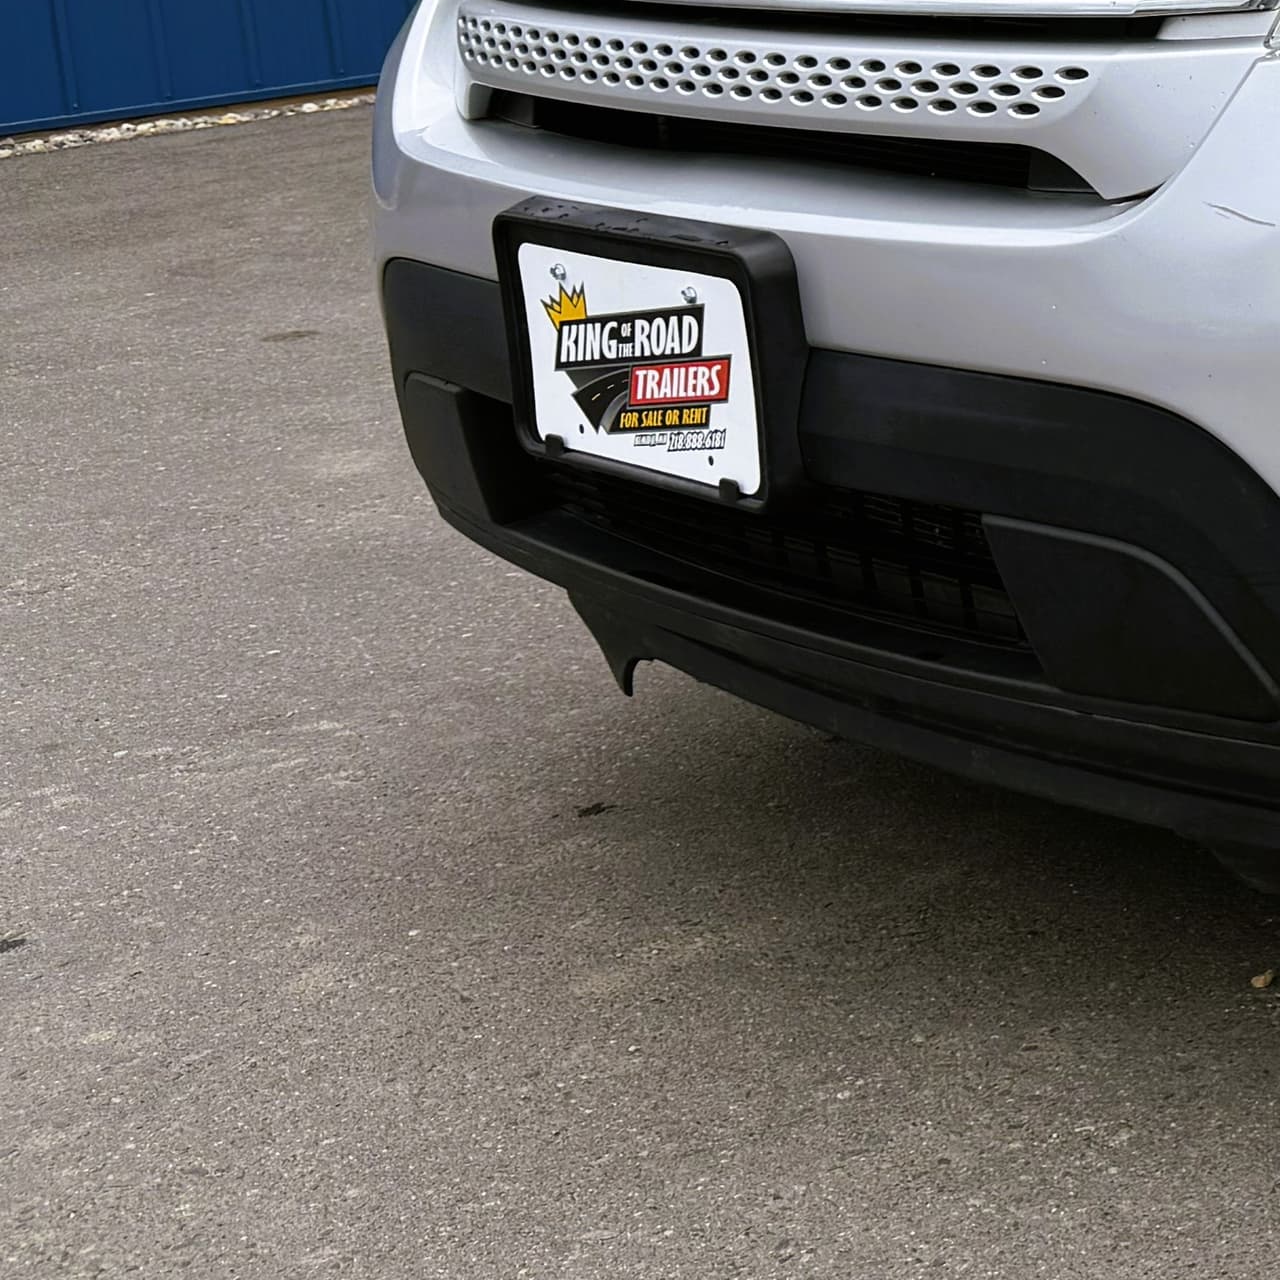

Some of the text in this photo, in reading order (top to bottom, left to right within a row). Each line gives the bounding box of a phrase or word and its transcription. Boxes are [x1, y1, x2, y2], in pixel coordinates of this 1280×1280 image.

[560, 315, 699, 363] KING OF THE ROAD
[635, 365, 722, 400] TRAILERS
[619, 407, 708, 428] FOR SALE OR RENT
[667, 428, 726, 452] 218.888.6181
